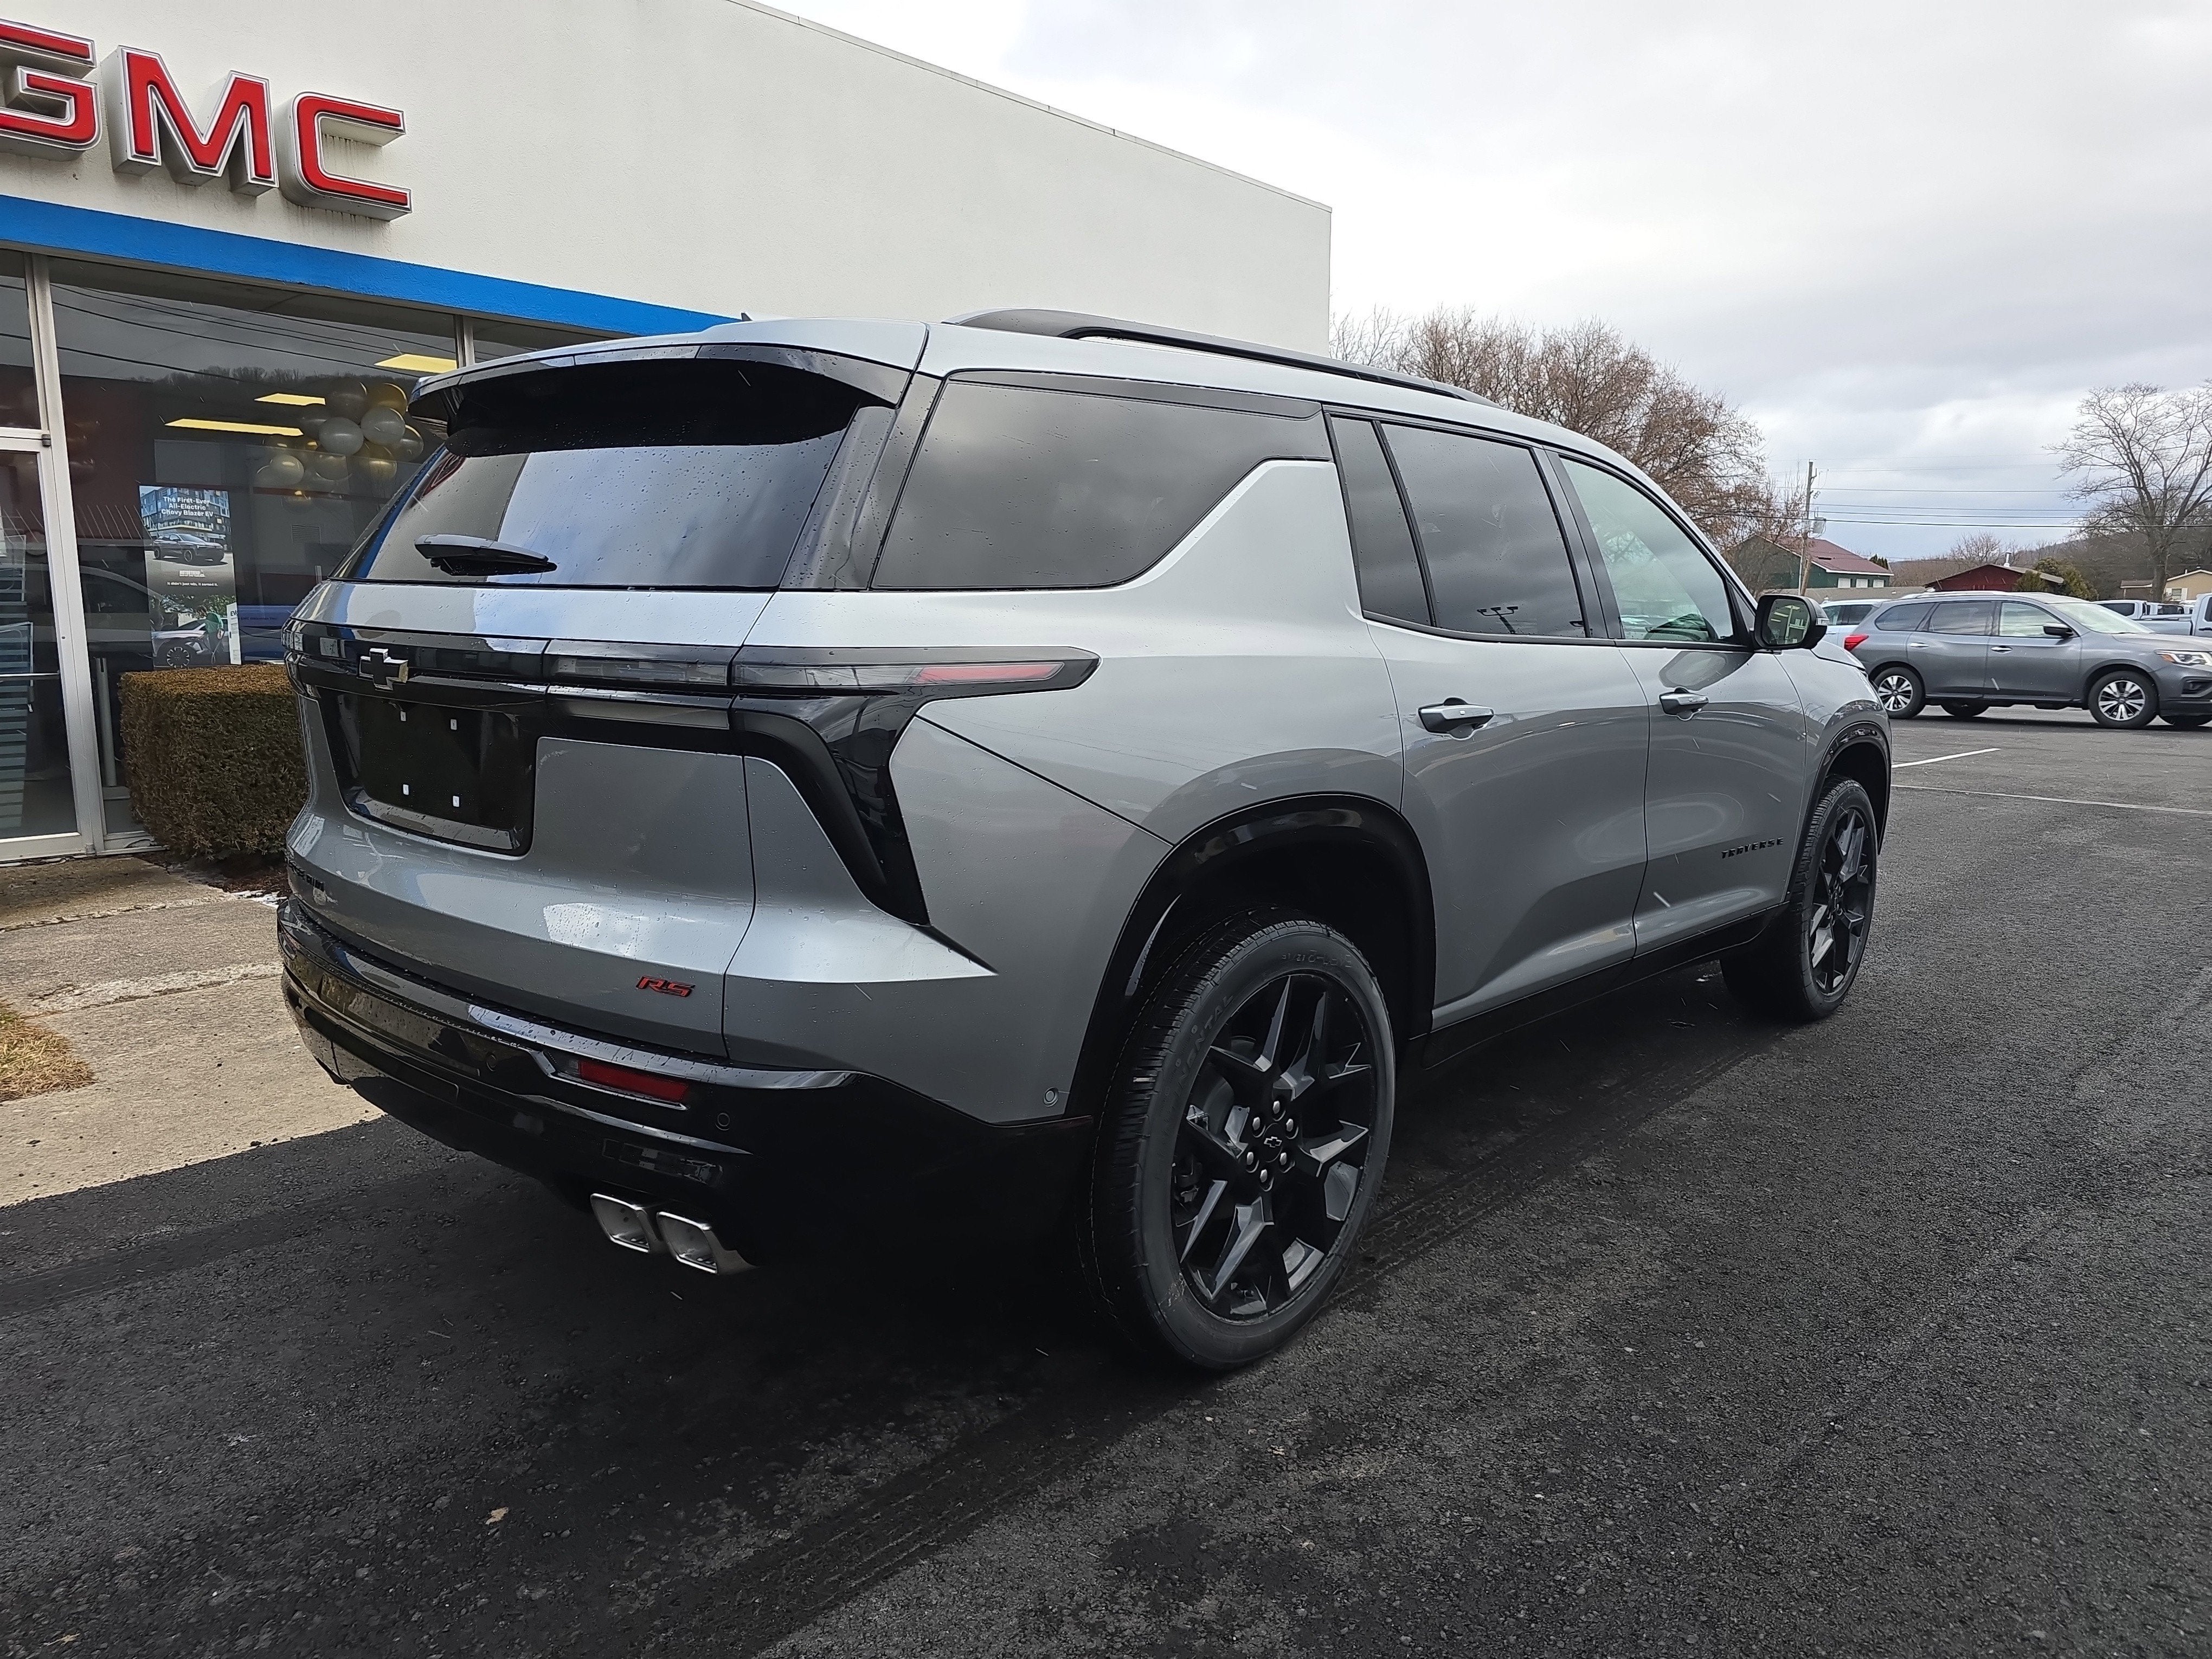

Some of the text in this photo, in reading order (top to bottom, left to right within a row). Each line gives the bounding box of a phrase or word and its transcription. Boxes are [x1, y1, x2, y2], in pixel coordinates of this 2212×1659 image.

[0, 19, 412, 218] GMC
[1721, 837, 1784, 859] TRAVERSE
[635, 975, 696, 998] RS
